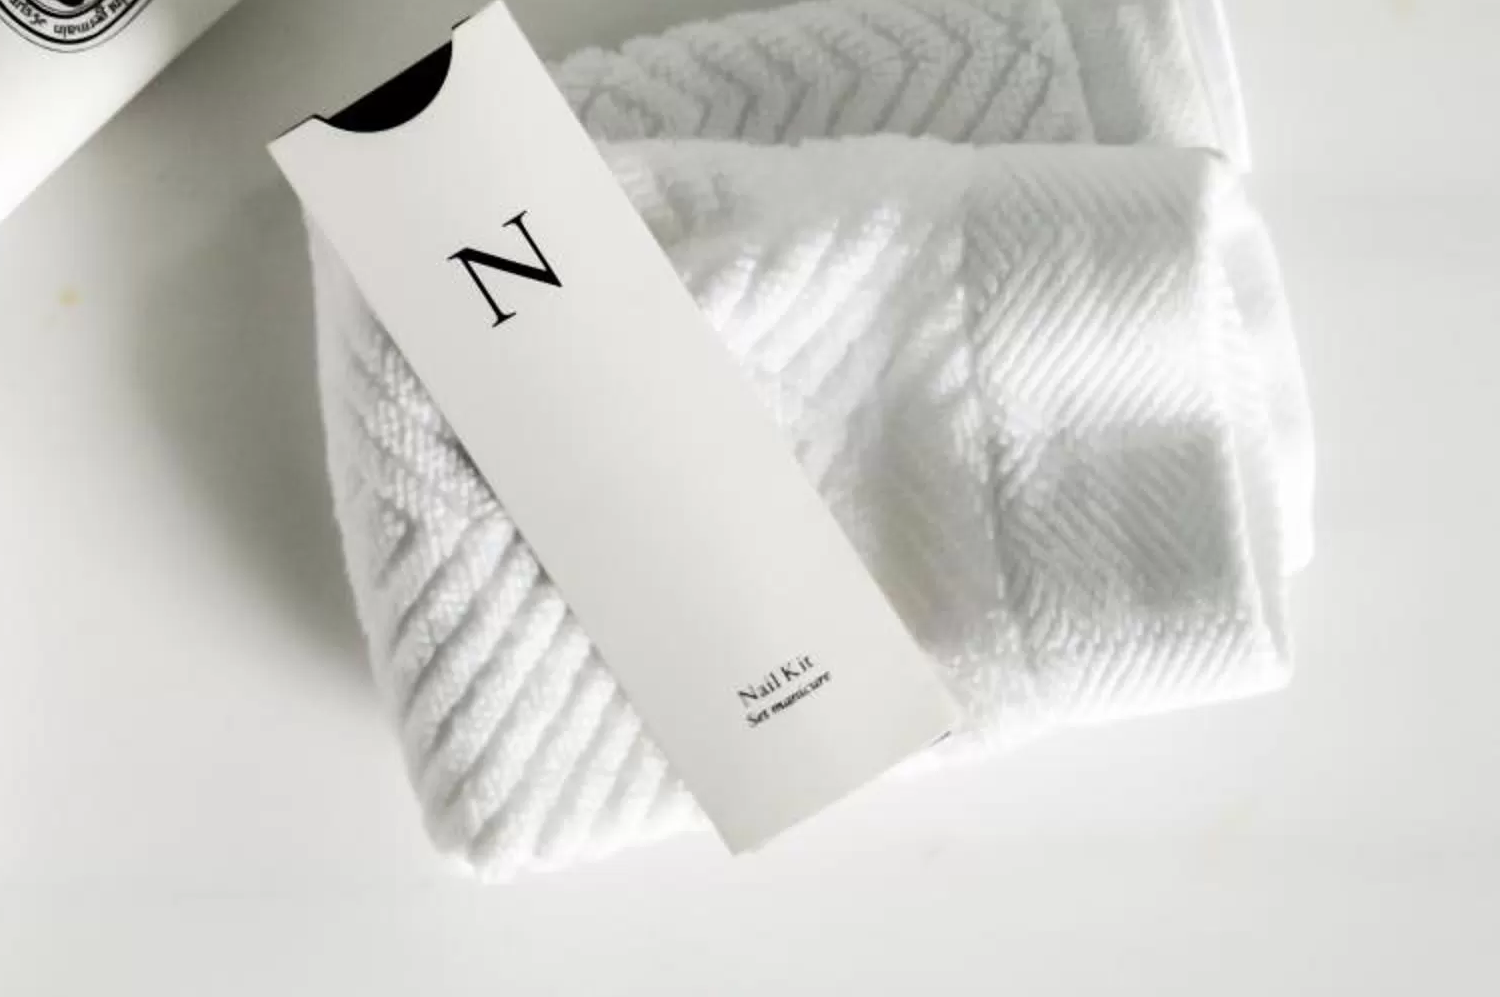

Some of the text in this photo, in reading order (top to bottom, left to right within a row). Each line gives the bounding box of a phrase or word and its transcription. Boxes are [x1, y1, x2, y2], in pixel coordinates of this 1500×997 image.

[447, 210, 563, 328] N
[737, 655, 814, 709] Nail Kit
[746, 671, 830, 728] Set manicure
